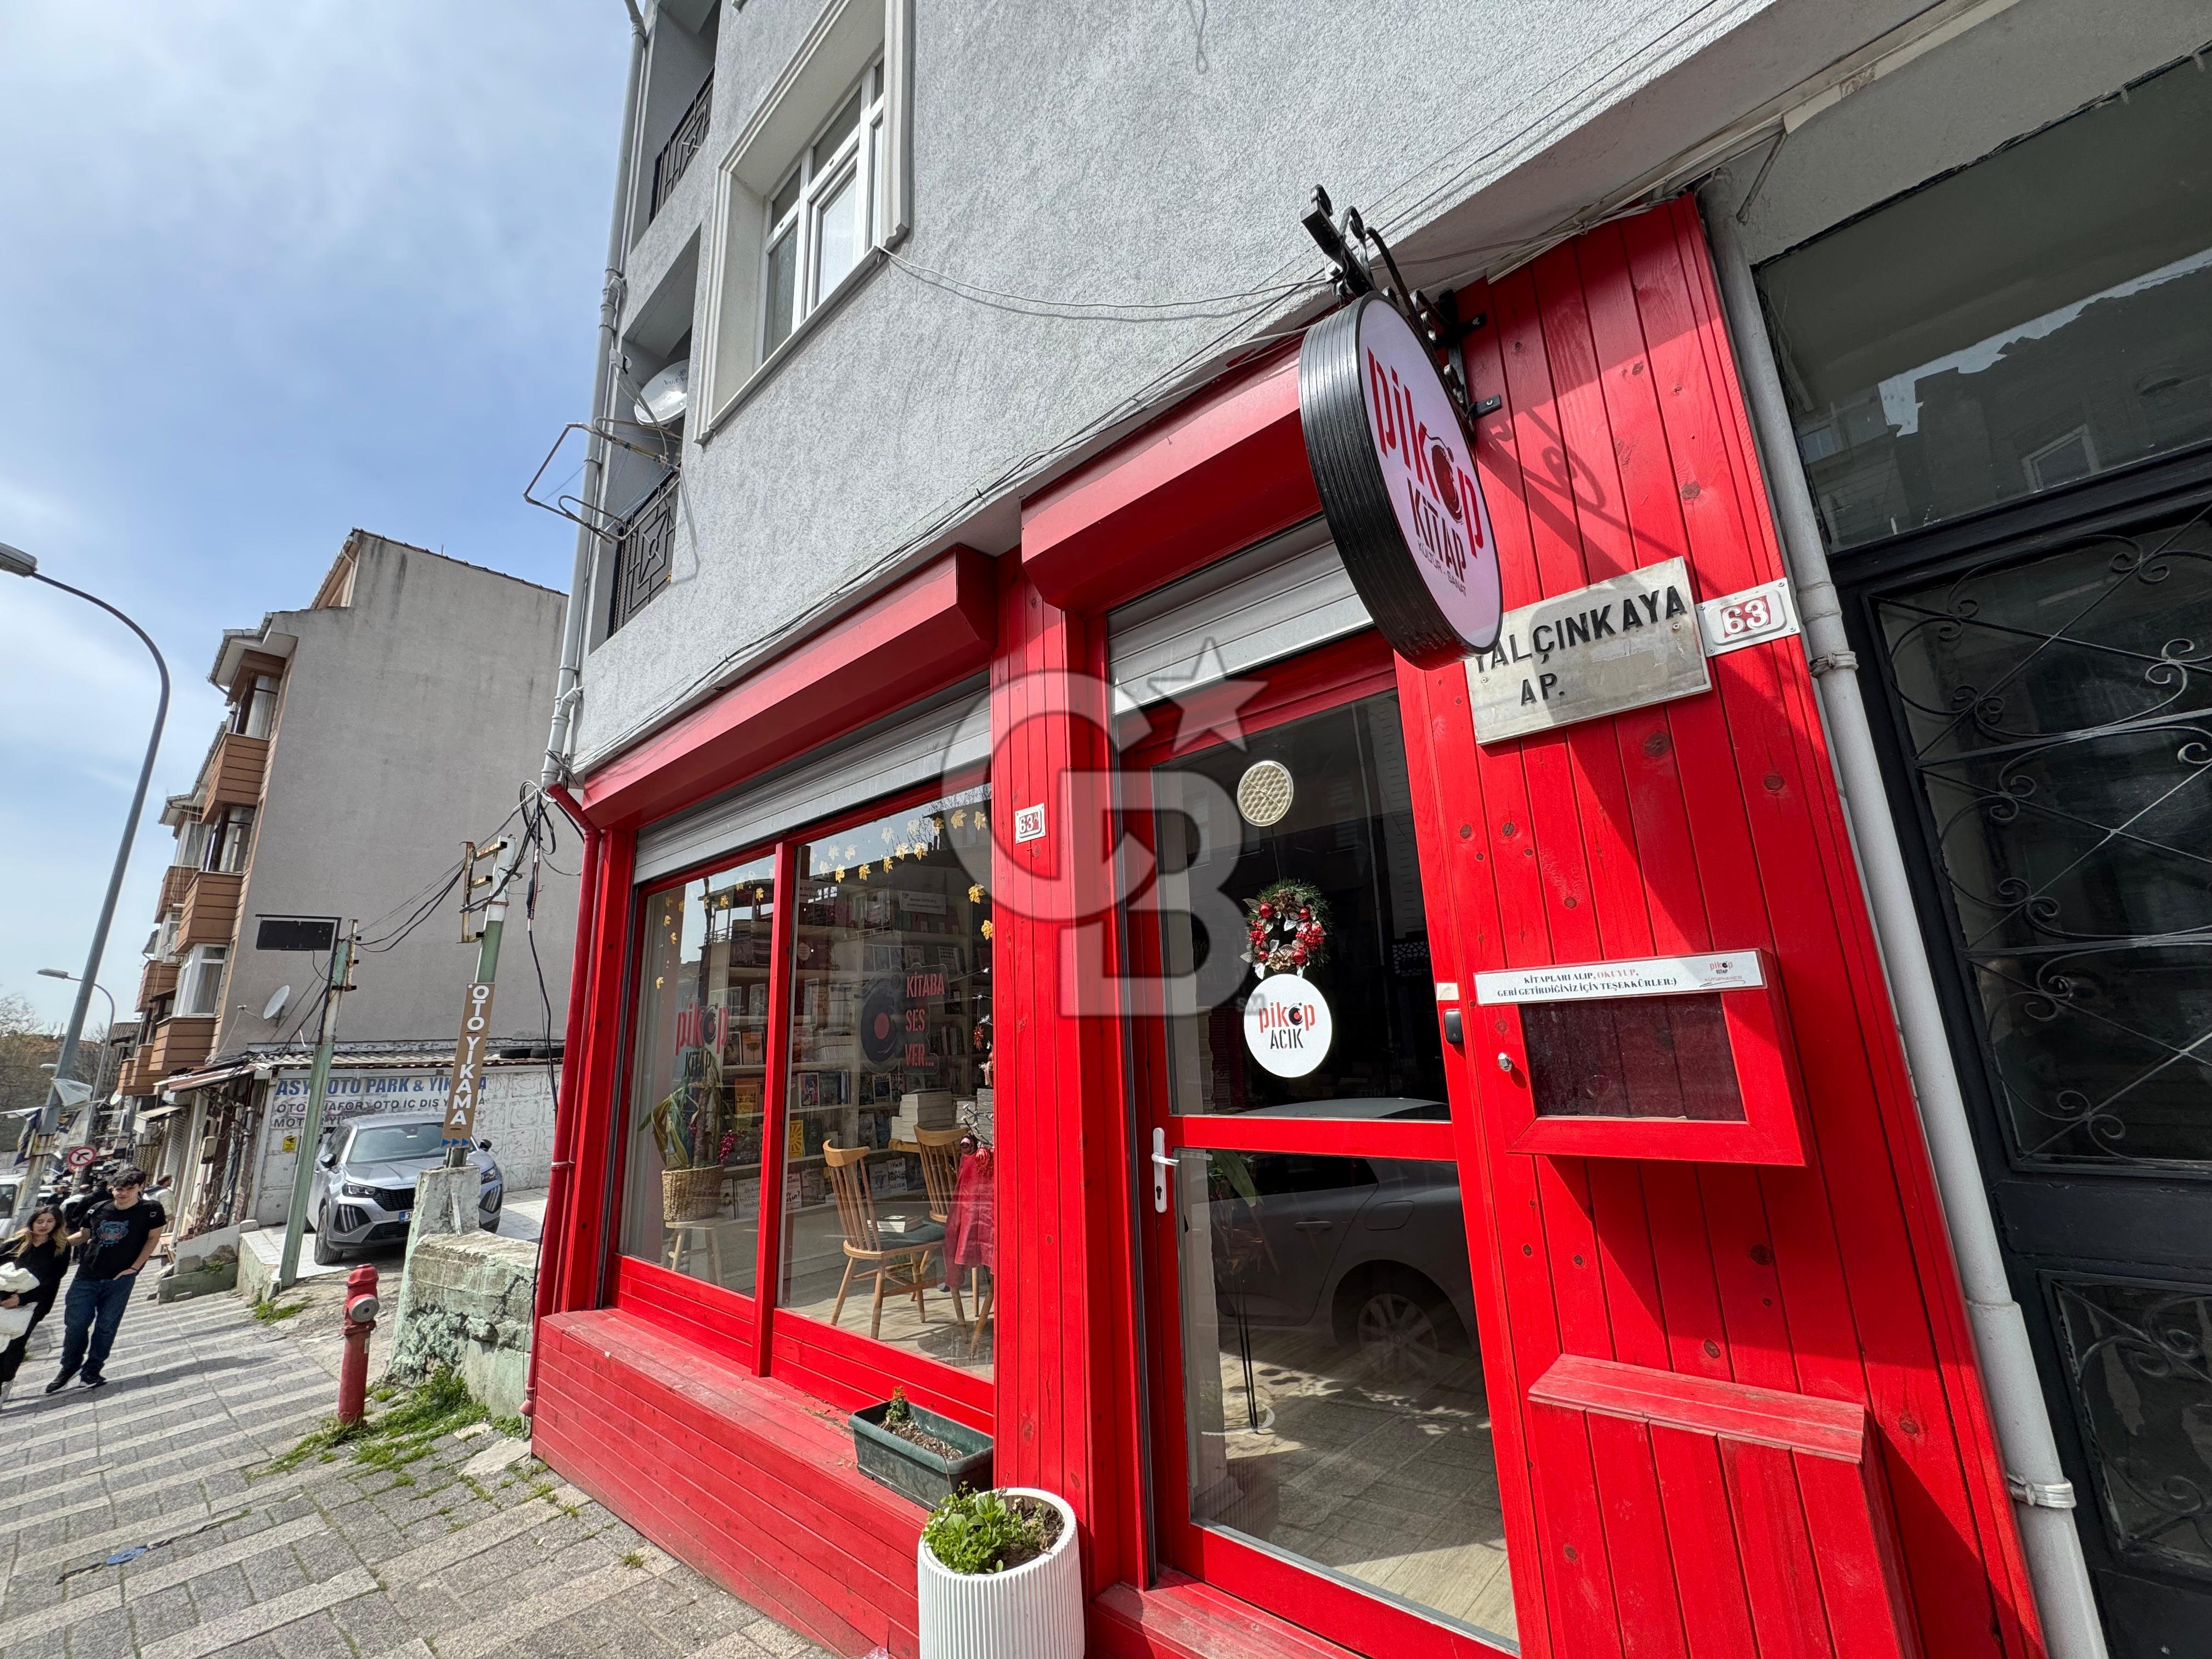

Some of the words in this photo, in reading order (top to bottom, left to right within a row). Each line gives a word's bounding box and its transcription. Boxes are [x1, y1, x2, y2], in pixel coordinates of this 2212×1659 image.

[1447, 571, 1467, 597] SANAT
[1722, 599, 1770, 635] 63
[1520, 673, 1566, 707] AP.
[906, 970, 945, 998] KİTABA
[1497, 987, 1517, 997] GERİ
[1519, 984, 1578, 996] GETİRDİĞİNİZ
[1579, 981, 1599, 993] İÇİN
[1523, 974, 1571, 984] KİTAPLARI
[1572, 972, 1596, 980] ALIP,
[1596, 969, 1639, 979] OKUYUP,
[467, 985, 490, 1031] OTO
[905, 1008, 926, 1031] SES
[275, 1079, 312, 1096] ASY
[328, 1079, 362, 1094] OTO
[365, 1077, 410, 1093] PARK
[413, 1079, 425, 1092] &
[429, 1076, 487, 1092] YIKA
[450, 1036, 481, 1125] YIKAMA
[277, 1103, 306, 1113] OTO
[373, 1100, 400, 1109] OTO
